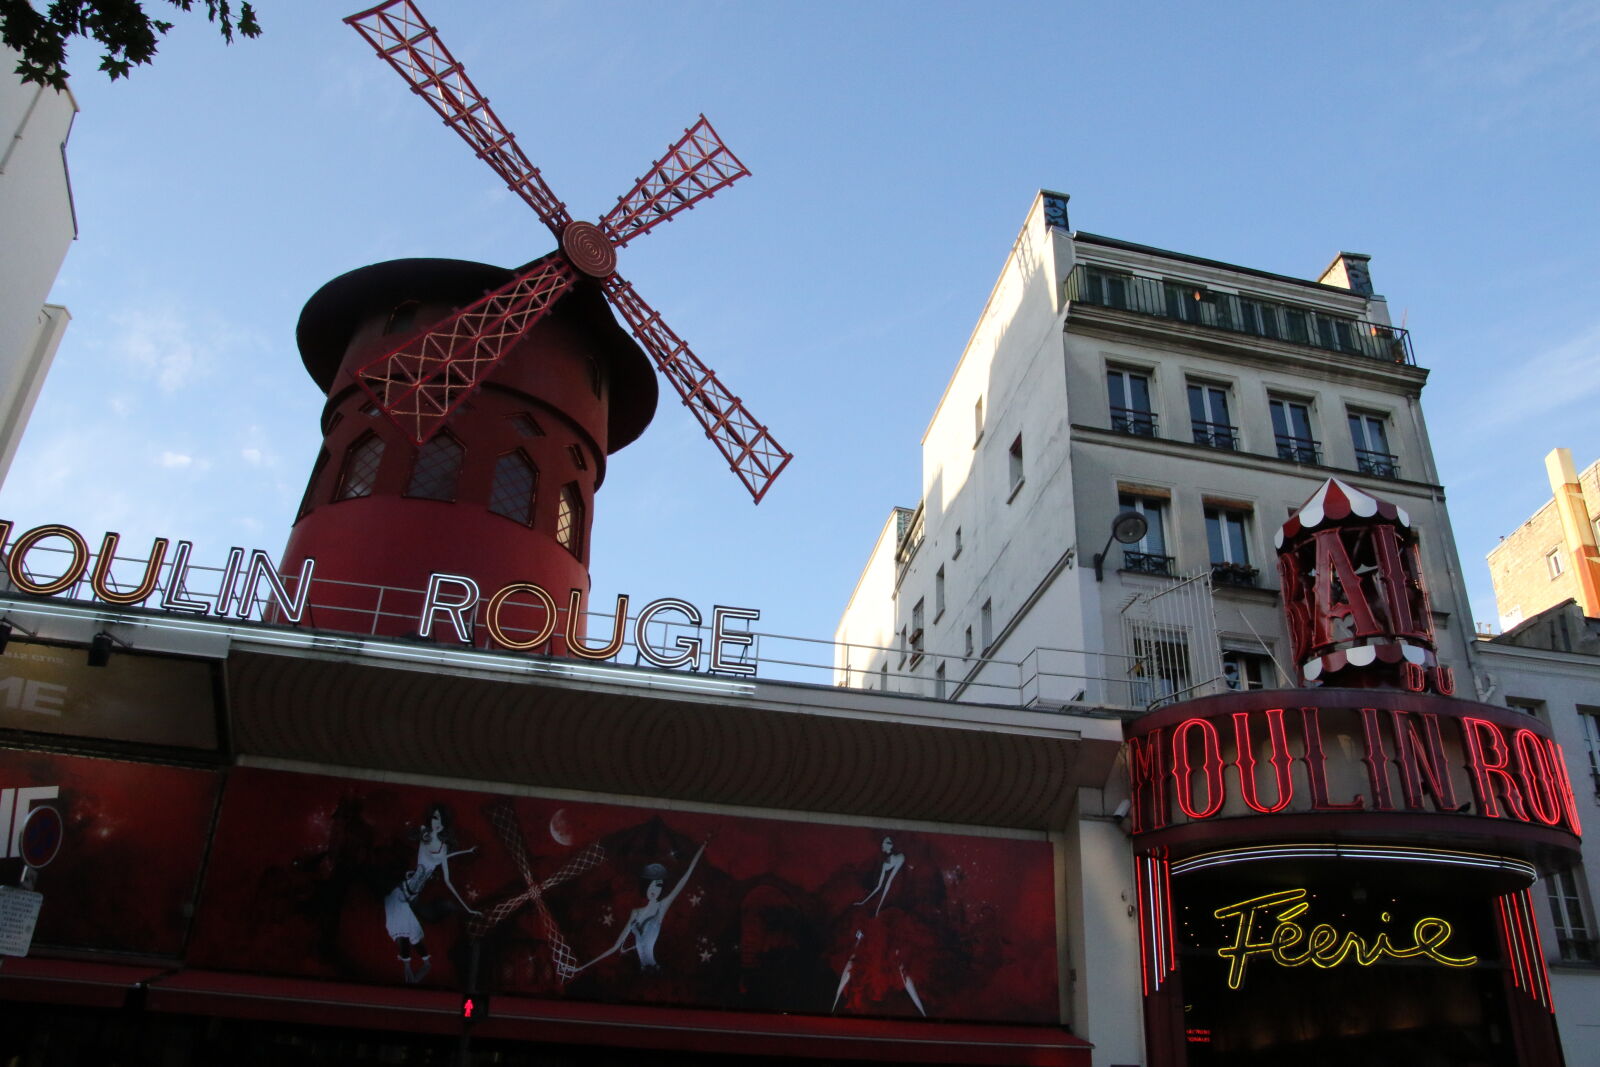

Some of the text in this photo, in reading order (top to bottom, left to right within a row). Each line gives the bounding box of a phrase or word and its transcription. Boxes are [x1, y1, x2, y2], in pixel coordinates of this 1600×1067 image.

[418, 571, 761, 677] ROUGE
[1278, 523, 1436, 670] BAL
[1404, 662, 1456, 696] DU
[1126, 706, 1458, 835] MOULIN
[1214, 888, 1480, 990] Féerie
